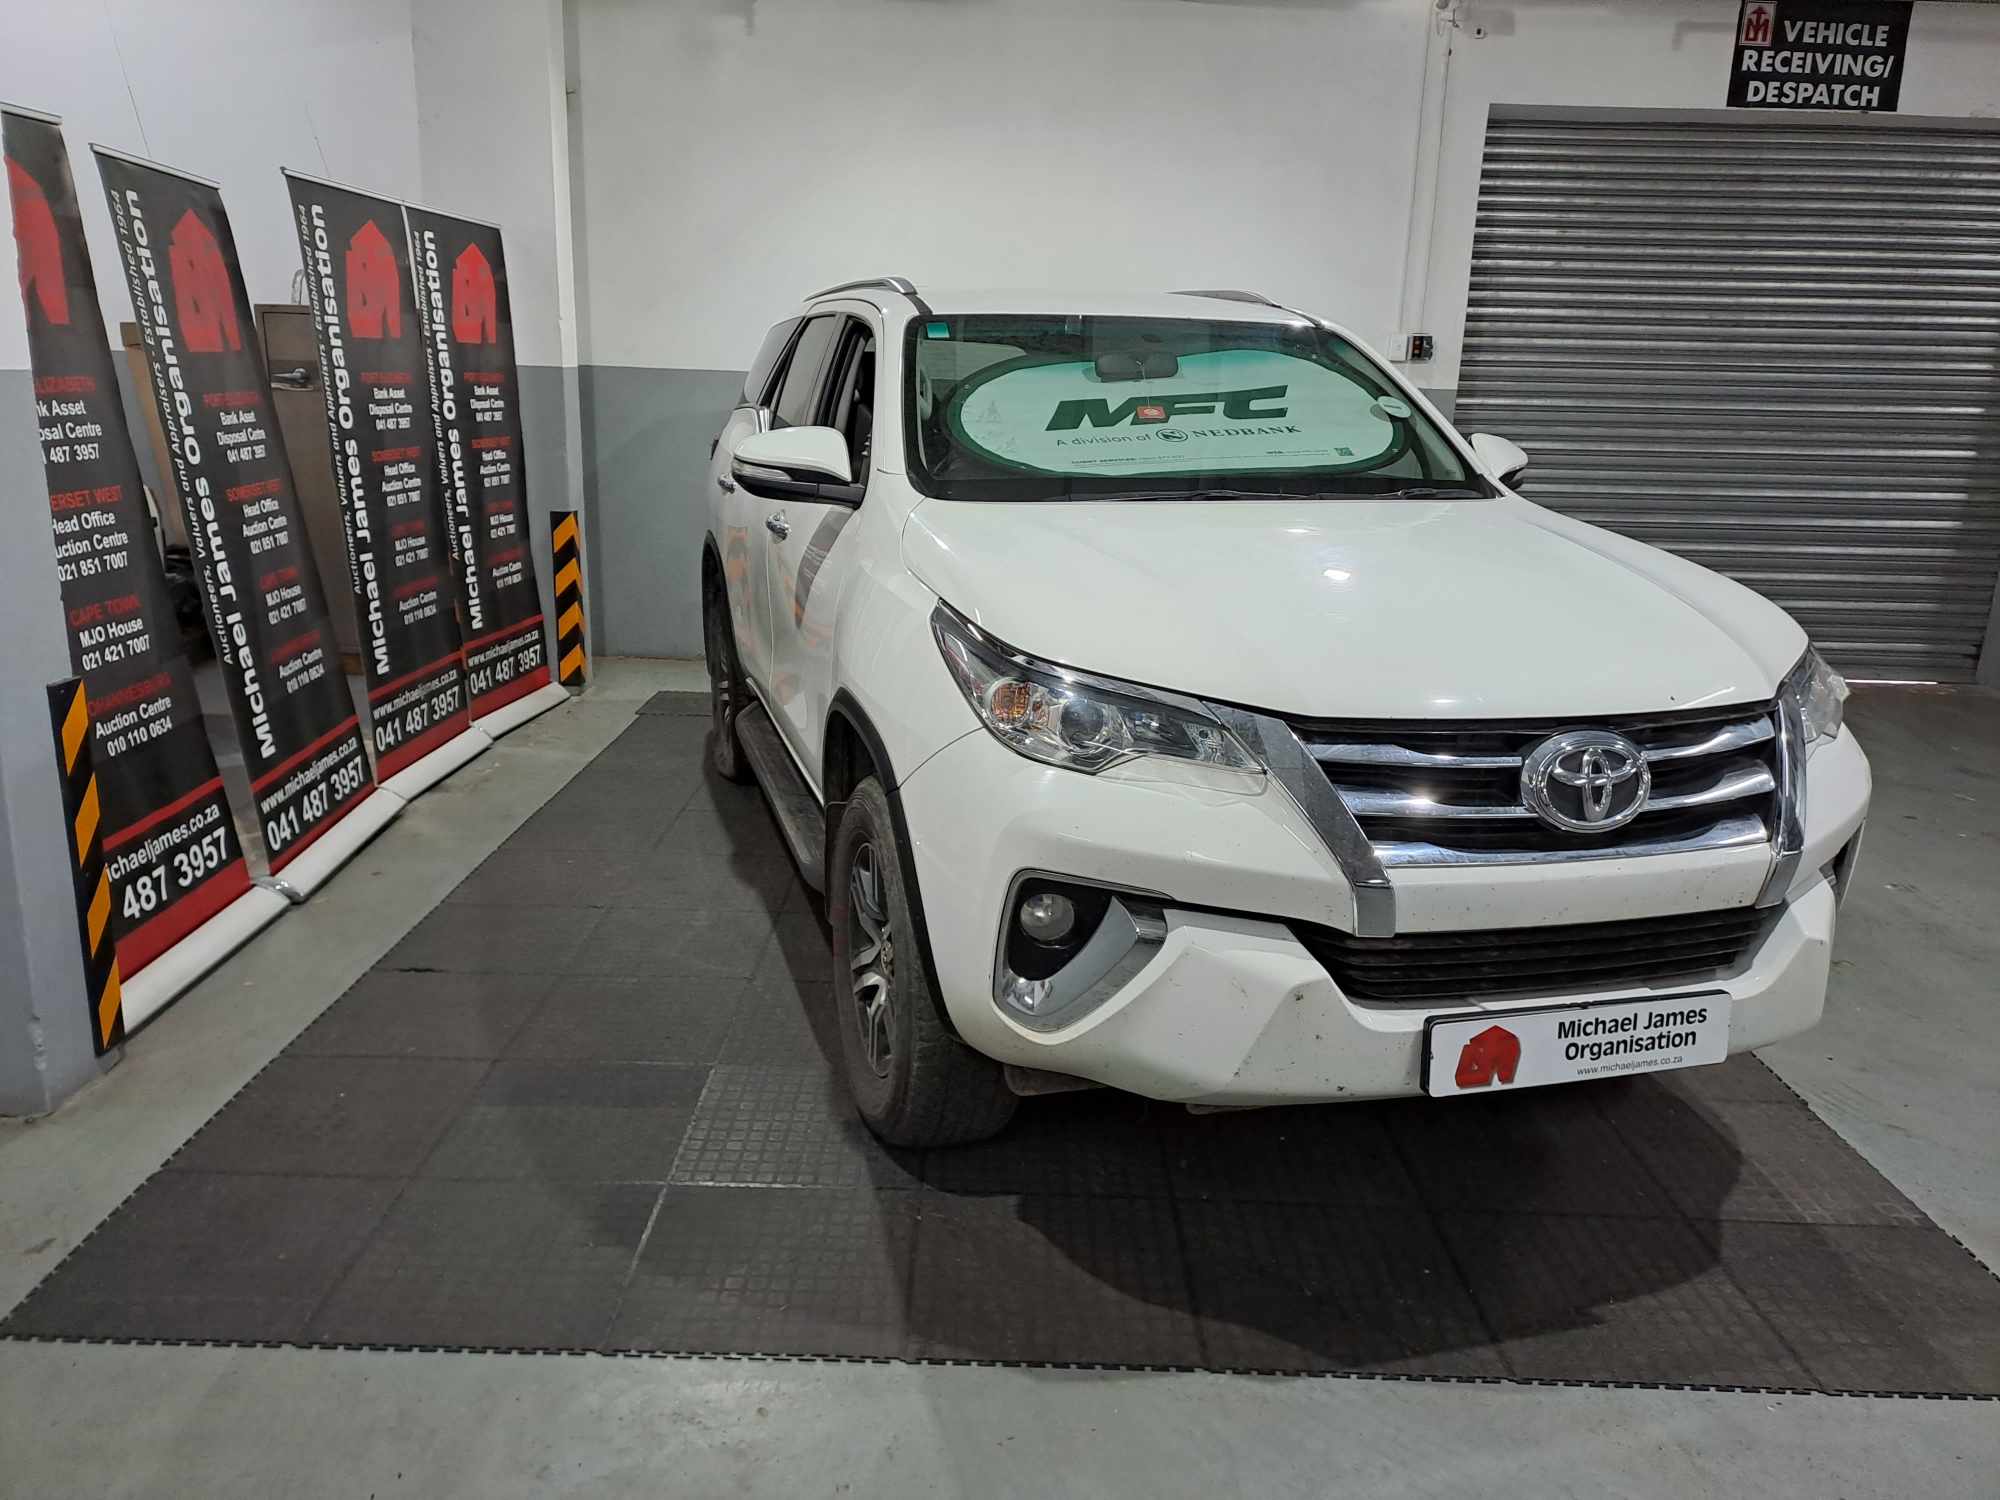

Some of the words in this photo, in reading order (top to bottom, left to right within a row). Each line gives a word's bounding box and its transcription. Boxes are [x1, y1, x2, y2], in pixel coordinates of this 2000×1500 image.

[1784, 20, 1890, 47] VEHICLE
[1741, 49, 1895, 79] RECEIVING/
[1746, 80, 1880, 108] DESPATCH
[110, 188, 128, 236] 1964
[122, 240, 155, 345] Established
[125, 189, 201, 466] Organisation
[311, 204, 354, 430] Organisation
[423, 230, 457, 421] Organisation
[52, 399, 87, 416] Asset
[65, 421, 103, 439] Centre
[152, 361, 181, 455] Appraisers
[1044, 384, 1289, 432] MFC
[1191, 425, 1302, 438] NEDBANK
[49, 446, 71, 464] 487
[73, 443, 99, 461] 3957
[174, 457, 190, 492] and
[448, 428, 469, 518] James
[345, 438, 372, 544] James
[81, 510, 116, 530] Office
[92, 530, 129, 550] Centre
[186, 496, 206, 559] Valuers
[194, 476, 237, 602] James
[57, 562, 78, 582] 021
[79, 557, 101, 577] 851
[103, 551, 129, 571] 7007
[458, 524, 483, 630] Michael
[79, 626, 106, 649] MJO
[106, 617, 144, 639] House
[359, 551, 390, 675] Michael
[81, 650, 102, 671] 021
[104, 643, 126, 664] 421
[126, 634, 151, 654] 7007
[470, 666, 492, 695] 041
[495, 657, 515, 683] 487
[518, 644, 542, 673] 3957
[226, 611, 277, 760] Michael
[95, 710, 139, 740] Auction
[139, 695, 173, 718] Centre
[106, 738, 127, 757] 010
[126, 728, 149, 747] 110
[149, 715, 173, 738] 0634
[375, 717, 402, 752] 041
[405, 702, 429, 734] 487
[431, 685, 460, 720] 3957
[260, 736, 358, 815] www.michaeljames.co.za
[267, 805, 301, 851] 041
[302, 781, 329, 823] 487
[330, 755, 365, 801] 3957
[122, 864, 169, 920] 487
[172, 825, 230, 888] 3957
[1557, 1012, 1638, 1040] Michael
[1643, 1007, 1708, 1031] James
[1565, 1028, 1697, 1062] Organisation
[1576, 1055, 1684, 1076] www.michaeljames.co.za
